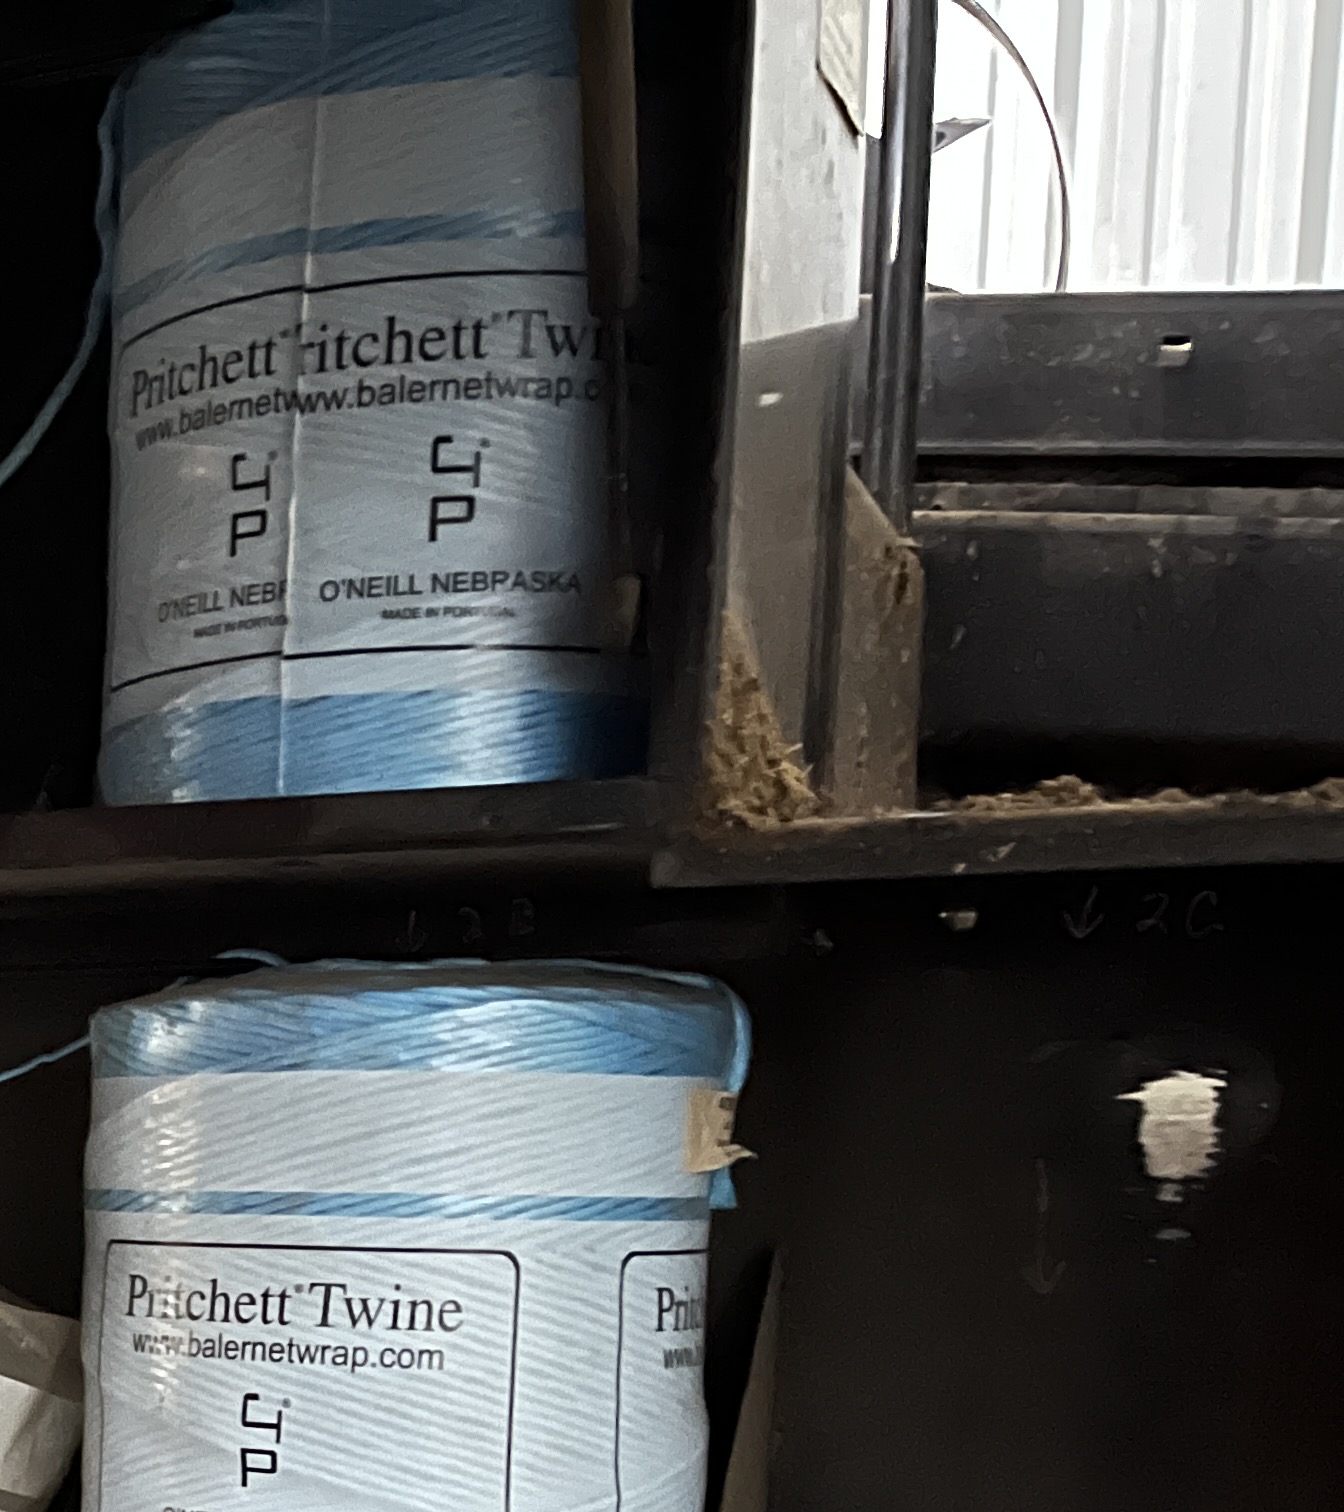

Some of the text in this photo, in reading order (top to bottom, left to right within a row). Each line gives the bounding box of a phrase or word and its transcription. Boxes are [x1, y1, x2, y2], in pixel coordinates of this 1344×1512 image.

[130, 335, 279, 420] Pritchett
[319, 569, 581, 602] O'NEILL NEBRASKA
[124, 1273, 465, 1333] Pritchett Twine
[132, 1330, 445, 1375] www.balernetwrap.com
